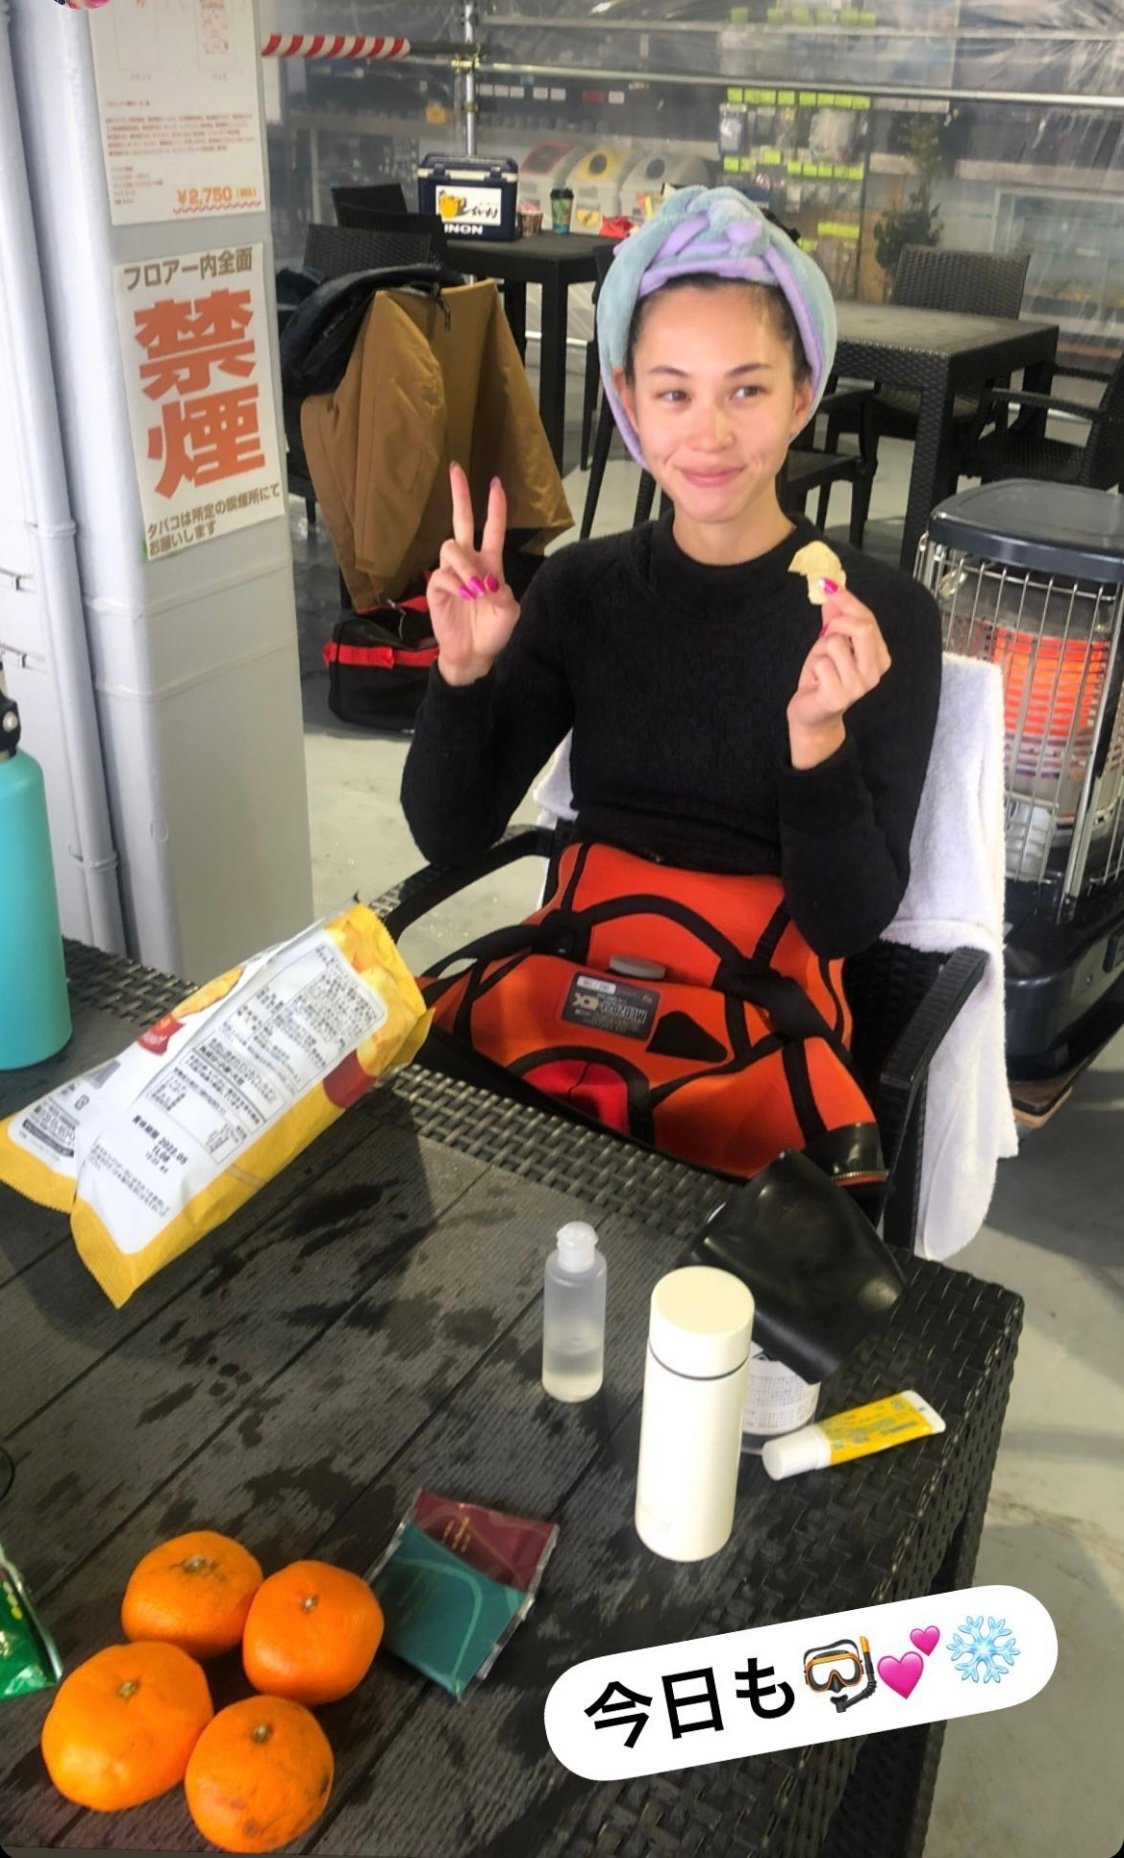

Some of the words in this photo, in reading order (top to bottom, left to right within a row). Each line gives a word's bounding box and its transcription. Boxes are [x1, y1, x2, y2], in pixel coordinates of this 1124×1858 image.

[177, 186, 232, 207] ¥2,750
[444, 224, 483, 235] INON
[124, 247, 253, 291] フロアー内全面
[133, 288, 266, 500] 禁煙
[149, 520, 217, 557] お願いします
